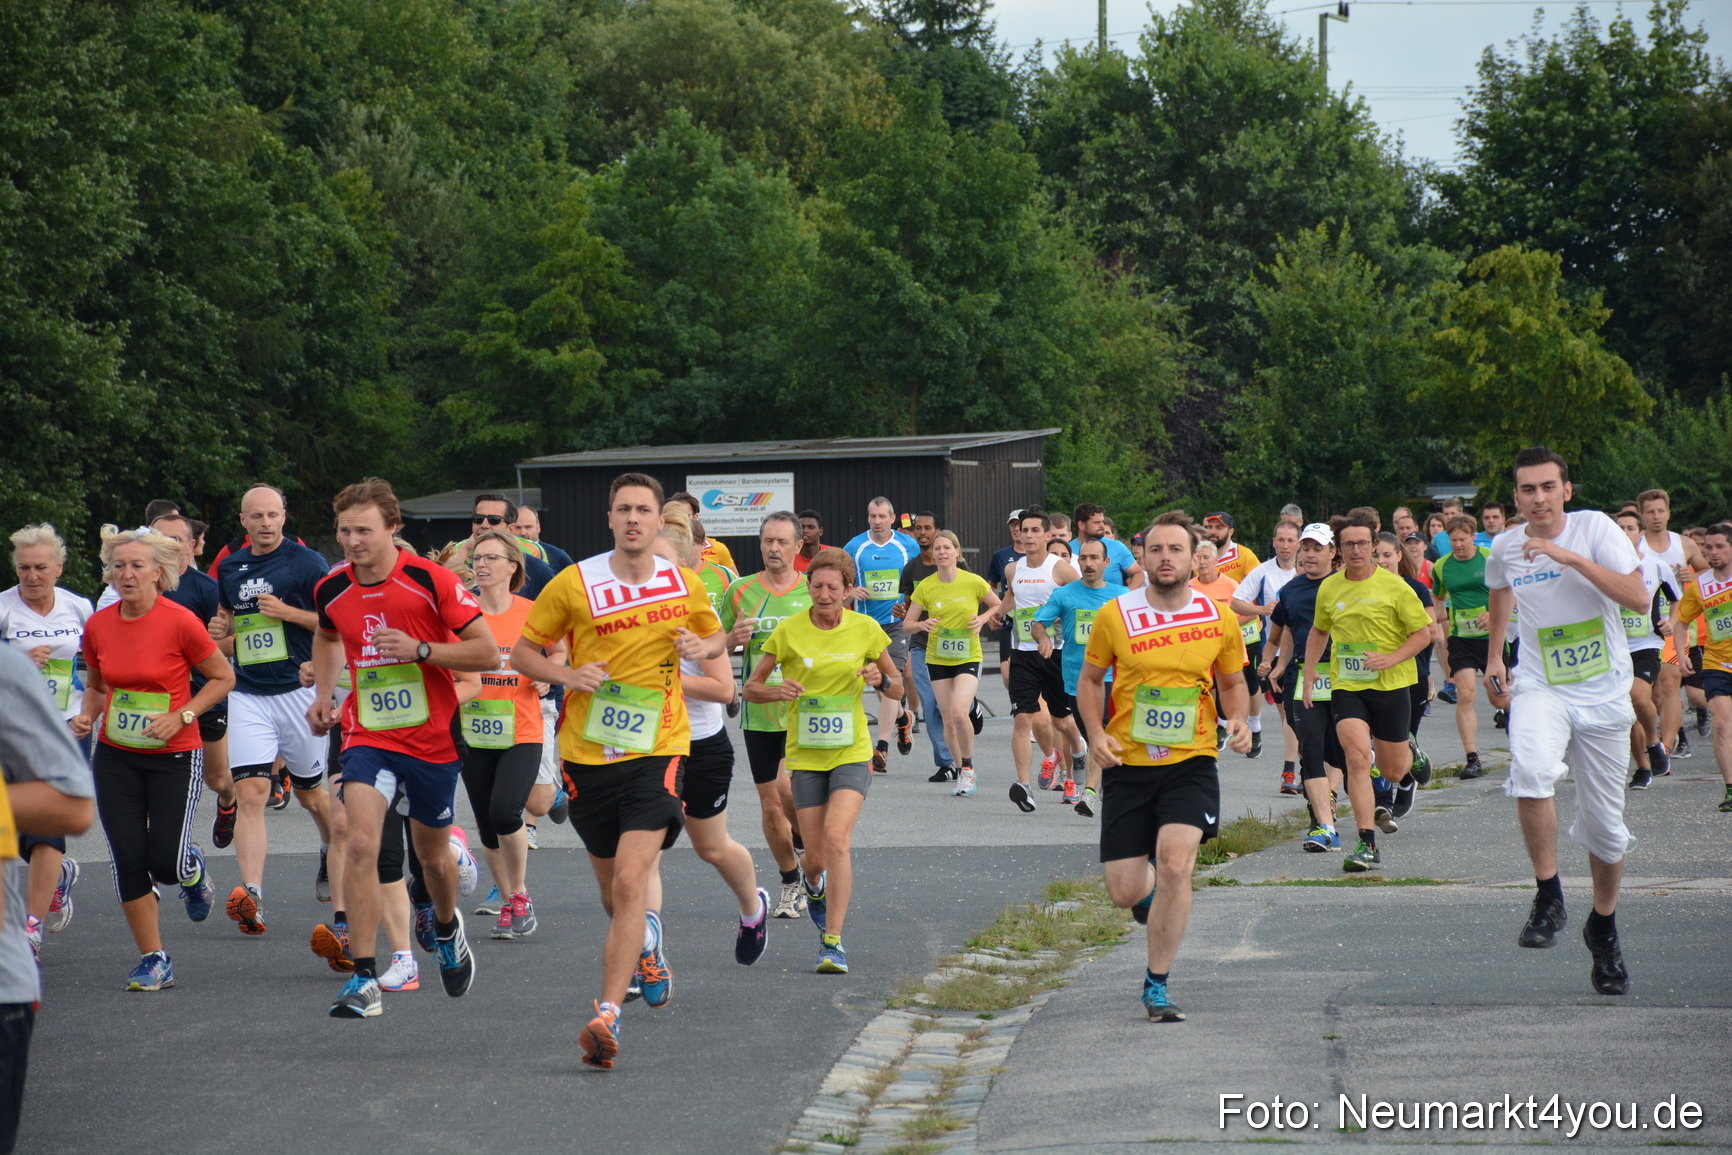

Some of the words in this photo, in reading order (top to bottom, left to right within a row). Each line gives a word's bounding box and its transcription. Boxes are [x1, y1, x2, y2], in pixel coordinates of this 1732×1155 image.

[711, 493, 749, 507] AST
[872, 581, 893, 592] 527
[1704, 595, 1727, 610] MAX
[595, 615, 641, 636] MAX
[646, 604, 689, 624] BÖGL
[1716, 616, 1732, 631] 86
[16, 628, 81, 638] DELPHI
[1242, 626, 1254, 637] 34
[244, 632, 274, 651] 169
[942, 640, 965, 651] 616
[1130, 634, 1174, 655] MAX
[1178, 627, 1223, 643] BÖGL
[1551, 640, 1602, 668] 1322
[481, 676, 519, 687] umarkt
[371, 689, 411, 712] 960
[471, 718, 503, 735] 589
[601, 706, 645, 734] 892
[808, 716, 843, 734] 599
[1145, 709, 1185, 729] 899
